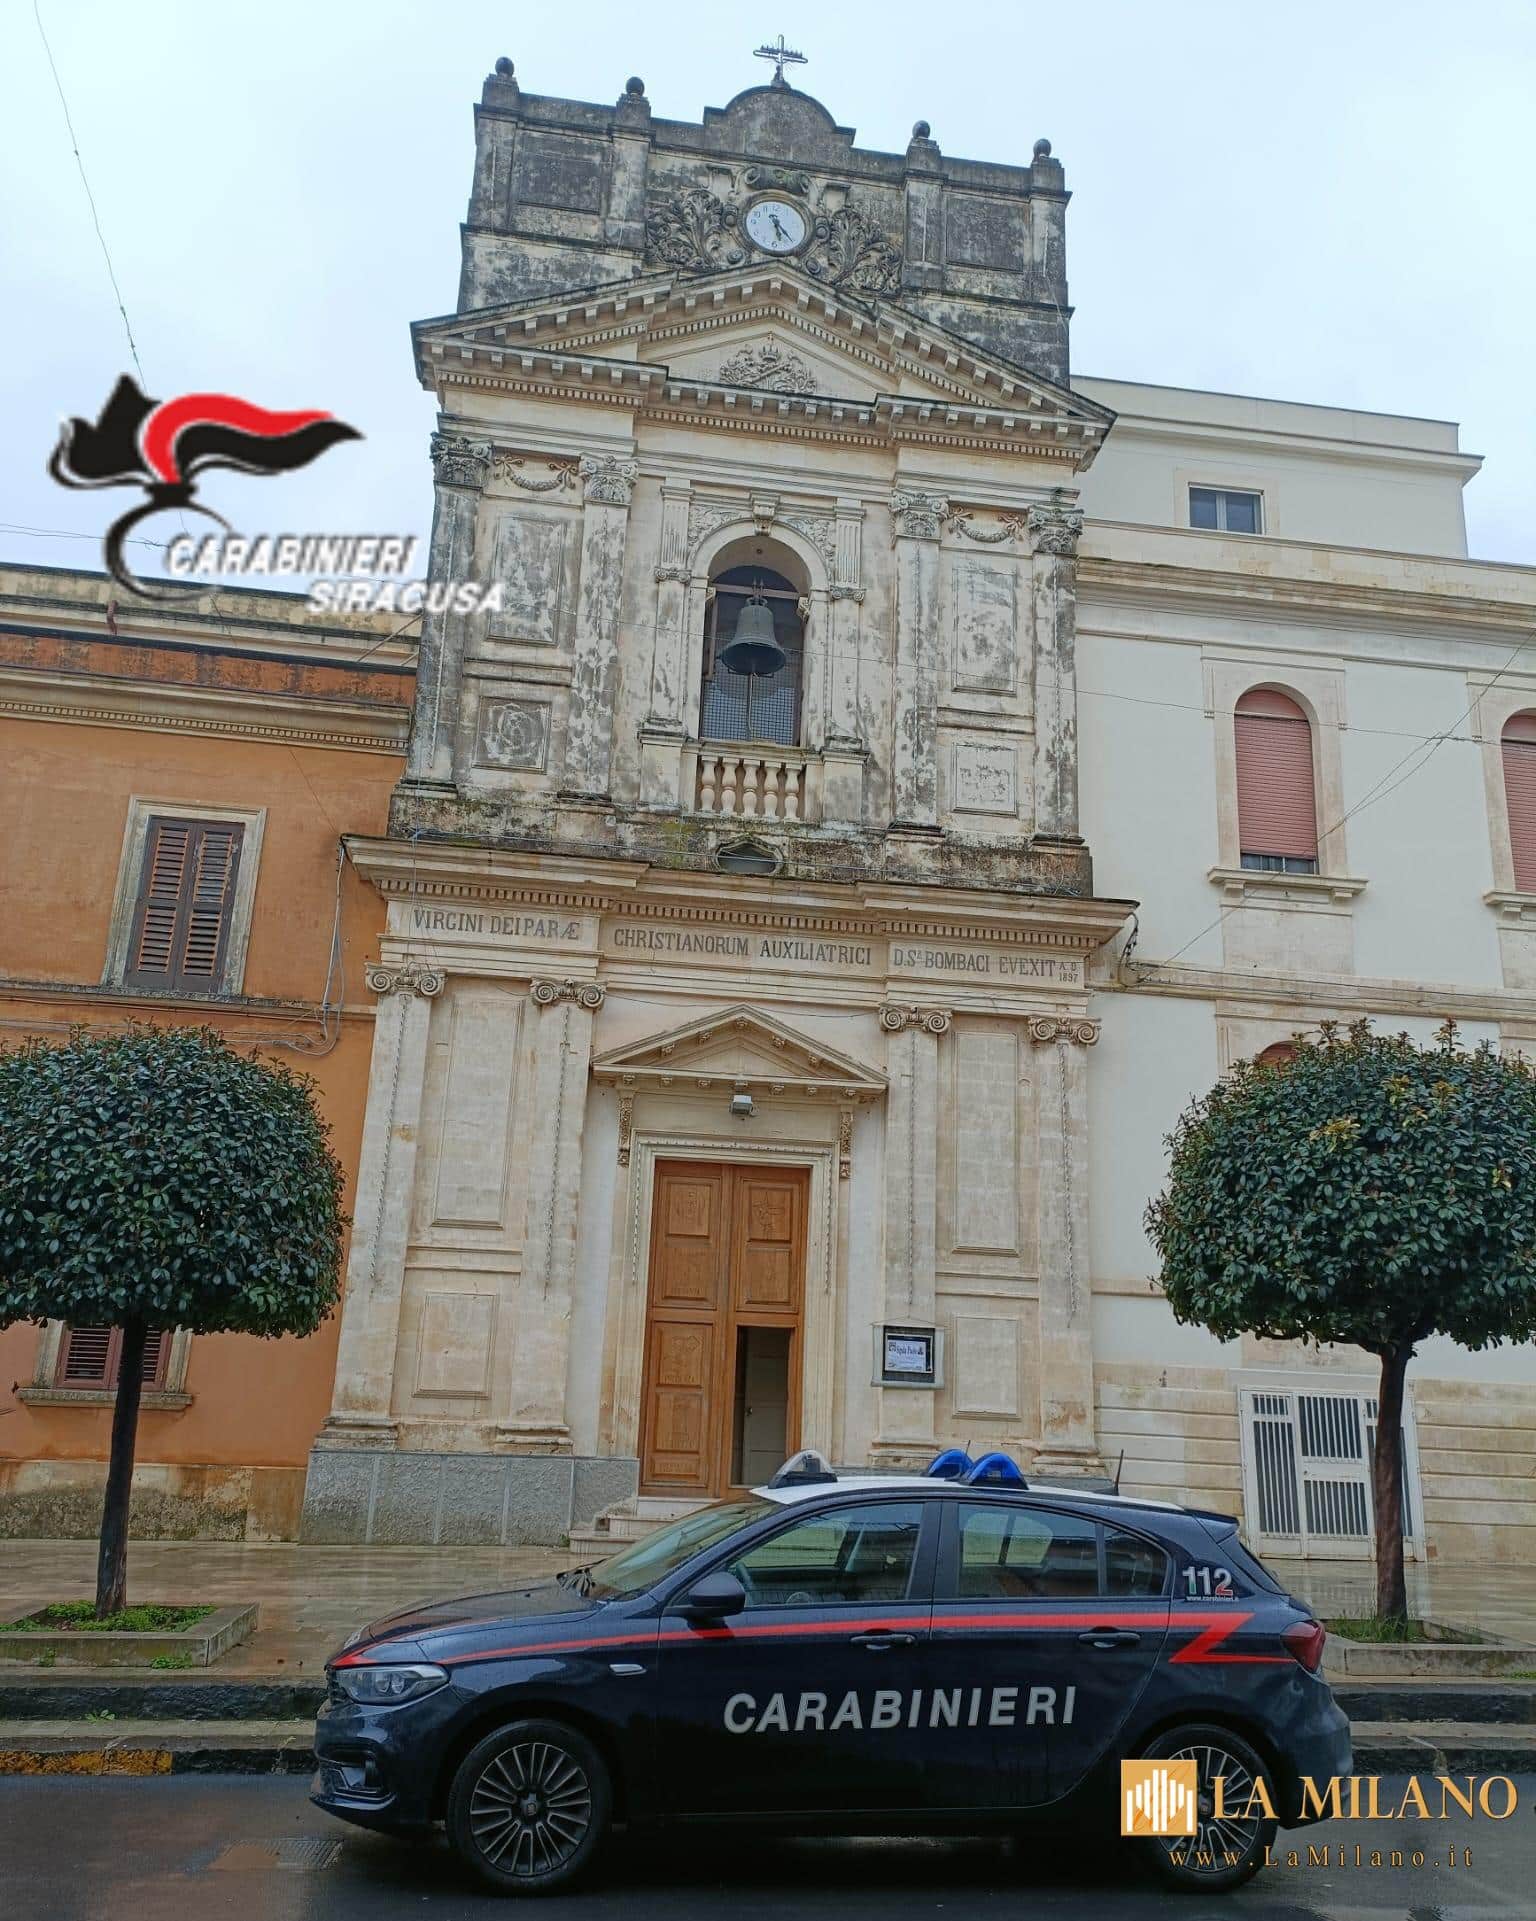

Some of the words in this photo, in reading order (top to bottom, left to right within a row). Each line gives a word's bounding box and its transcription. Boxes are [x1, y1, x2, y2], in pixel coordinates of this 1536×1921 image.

[413, 909, 485, 933] VIRGINI
[613, 928, 750, 956] CHRISTIANORUM
[759, 939, 872, 966] AUXILIATRICI
[925, 950, 991, 973] BOMBACI
[999, 956, 1056, 977] EVEXIT
[1182, 1566, 1234, 1596] 112
[723, 1685, 1077, 1735] CARABINIERI
